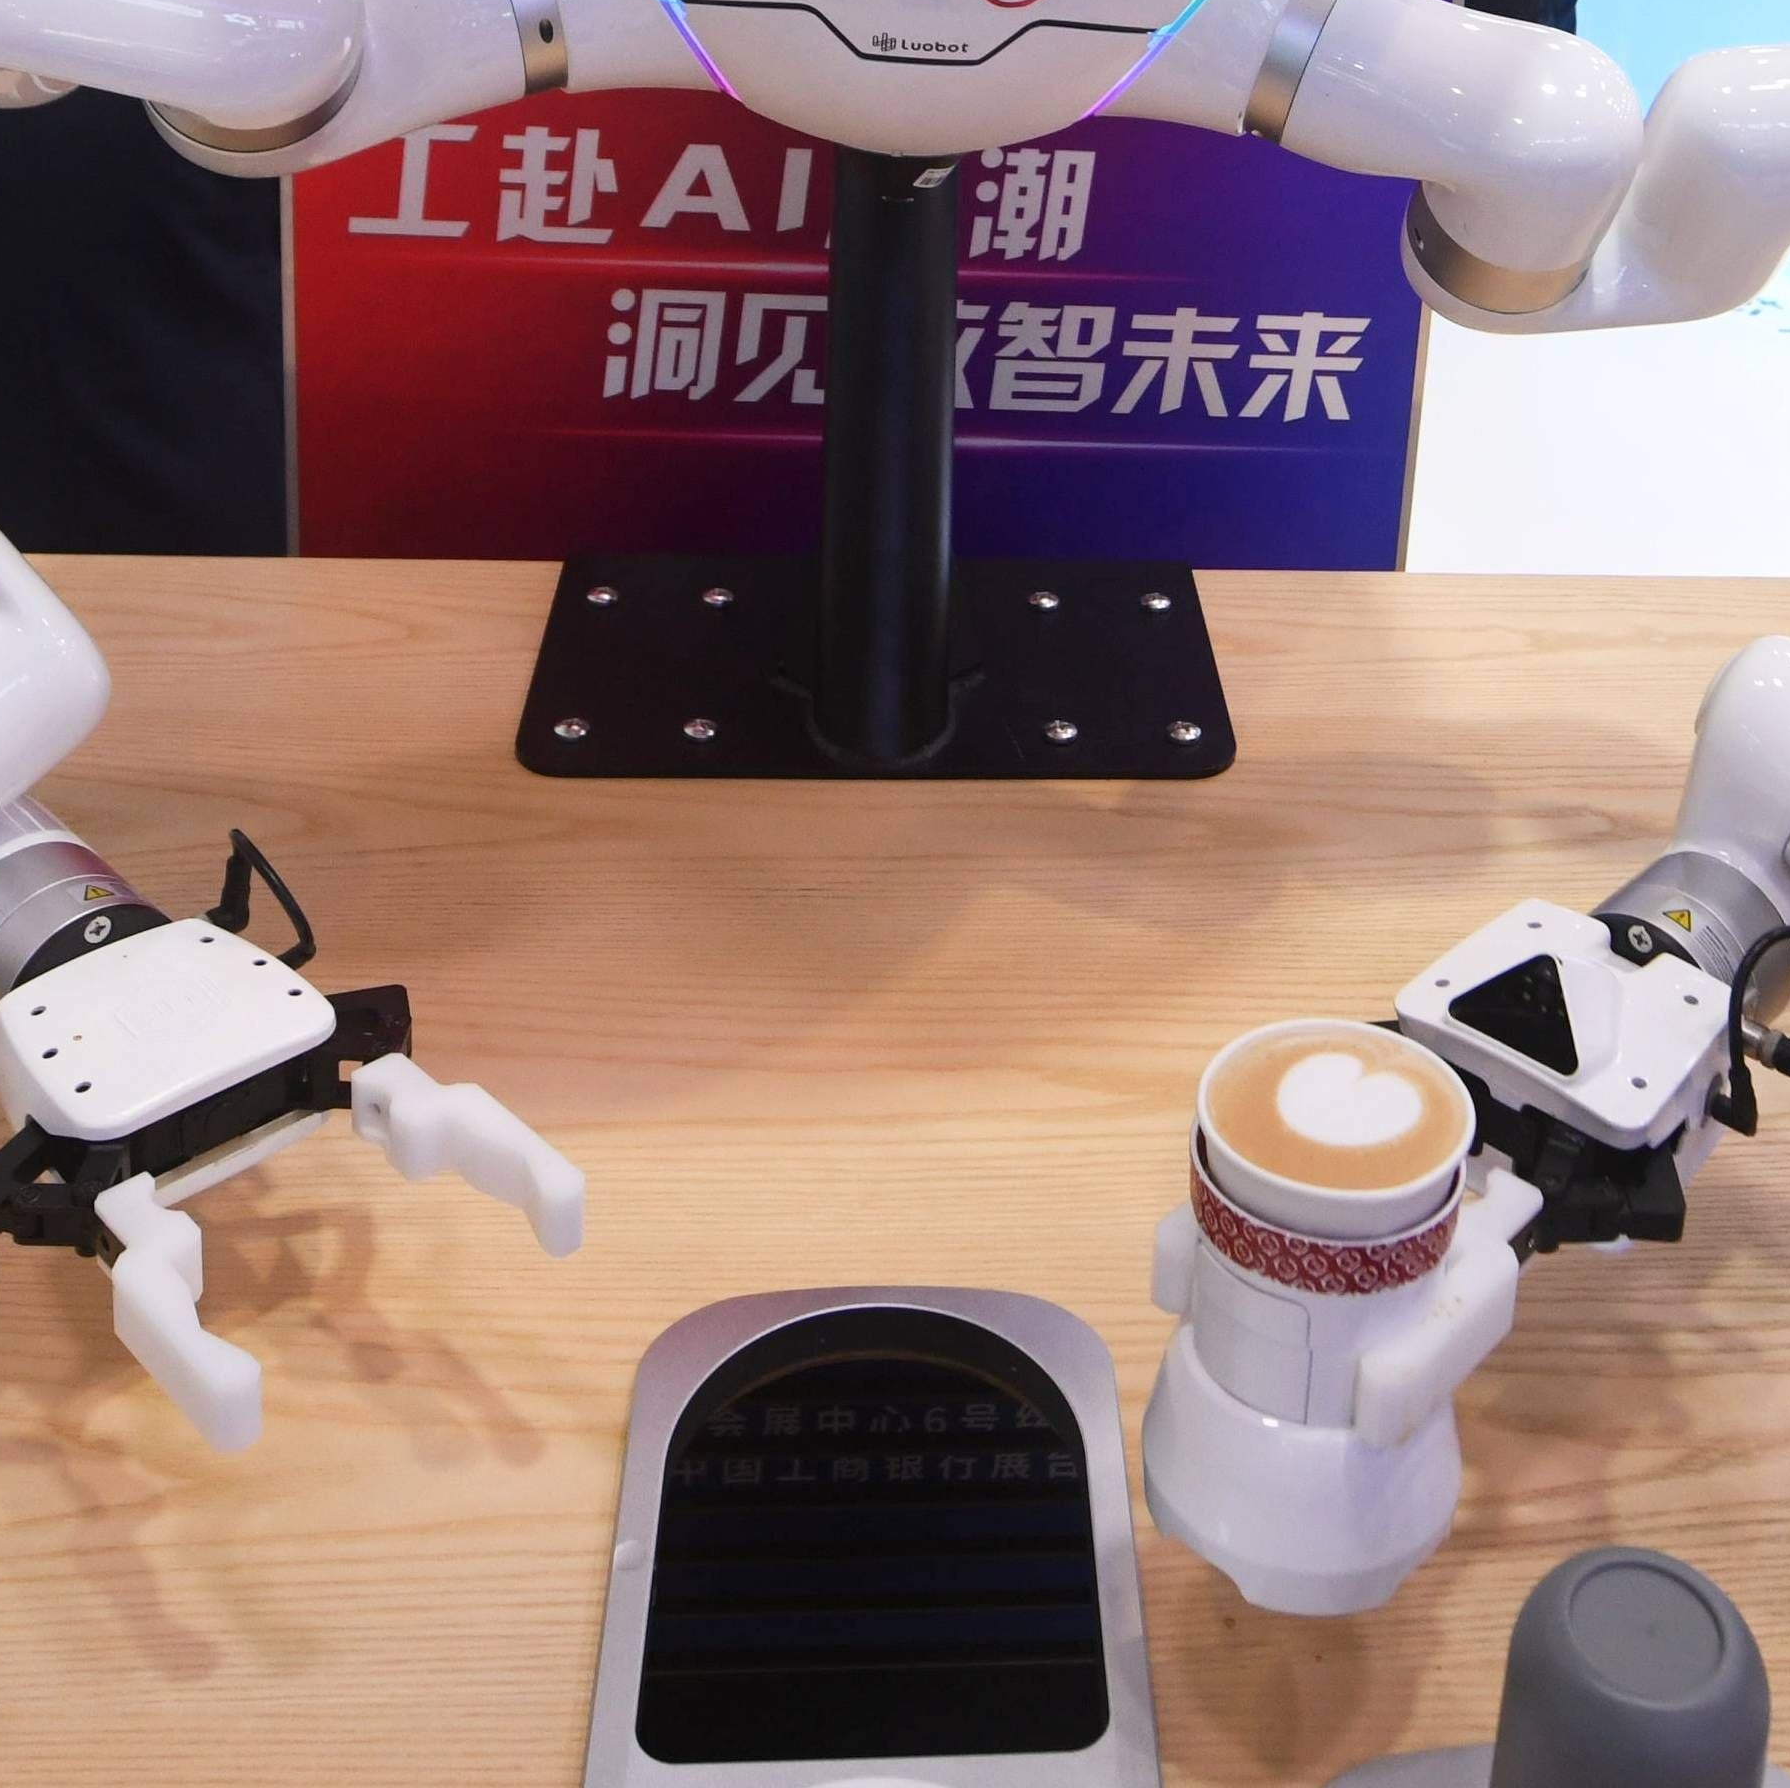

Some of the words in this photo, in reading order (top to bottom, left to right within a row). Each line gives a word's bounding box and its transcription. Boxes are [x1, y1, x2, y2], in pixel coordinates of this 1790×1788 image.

[900, 38, 969, 54] Luobot
[348, 123, 1097, 262] 工赴AI潮
